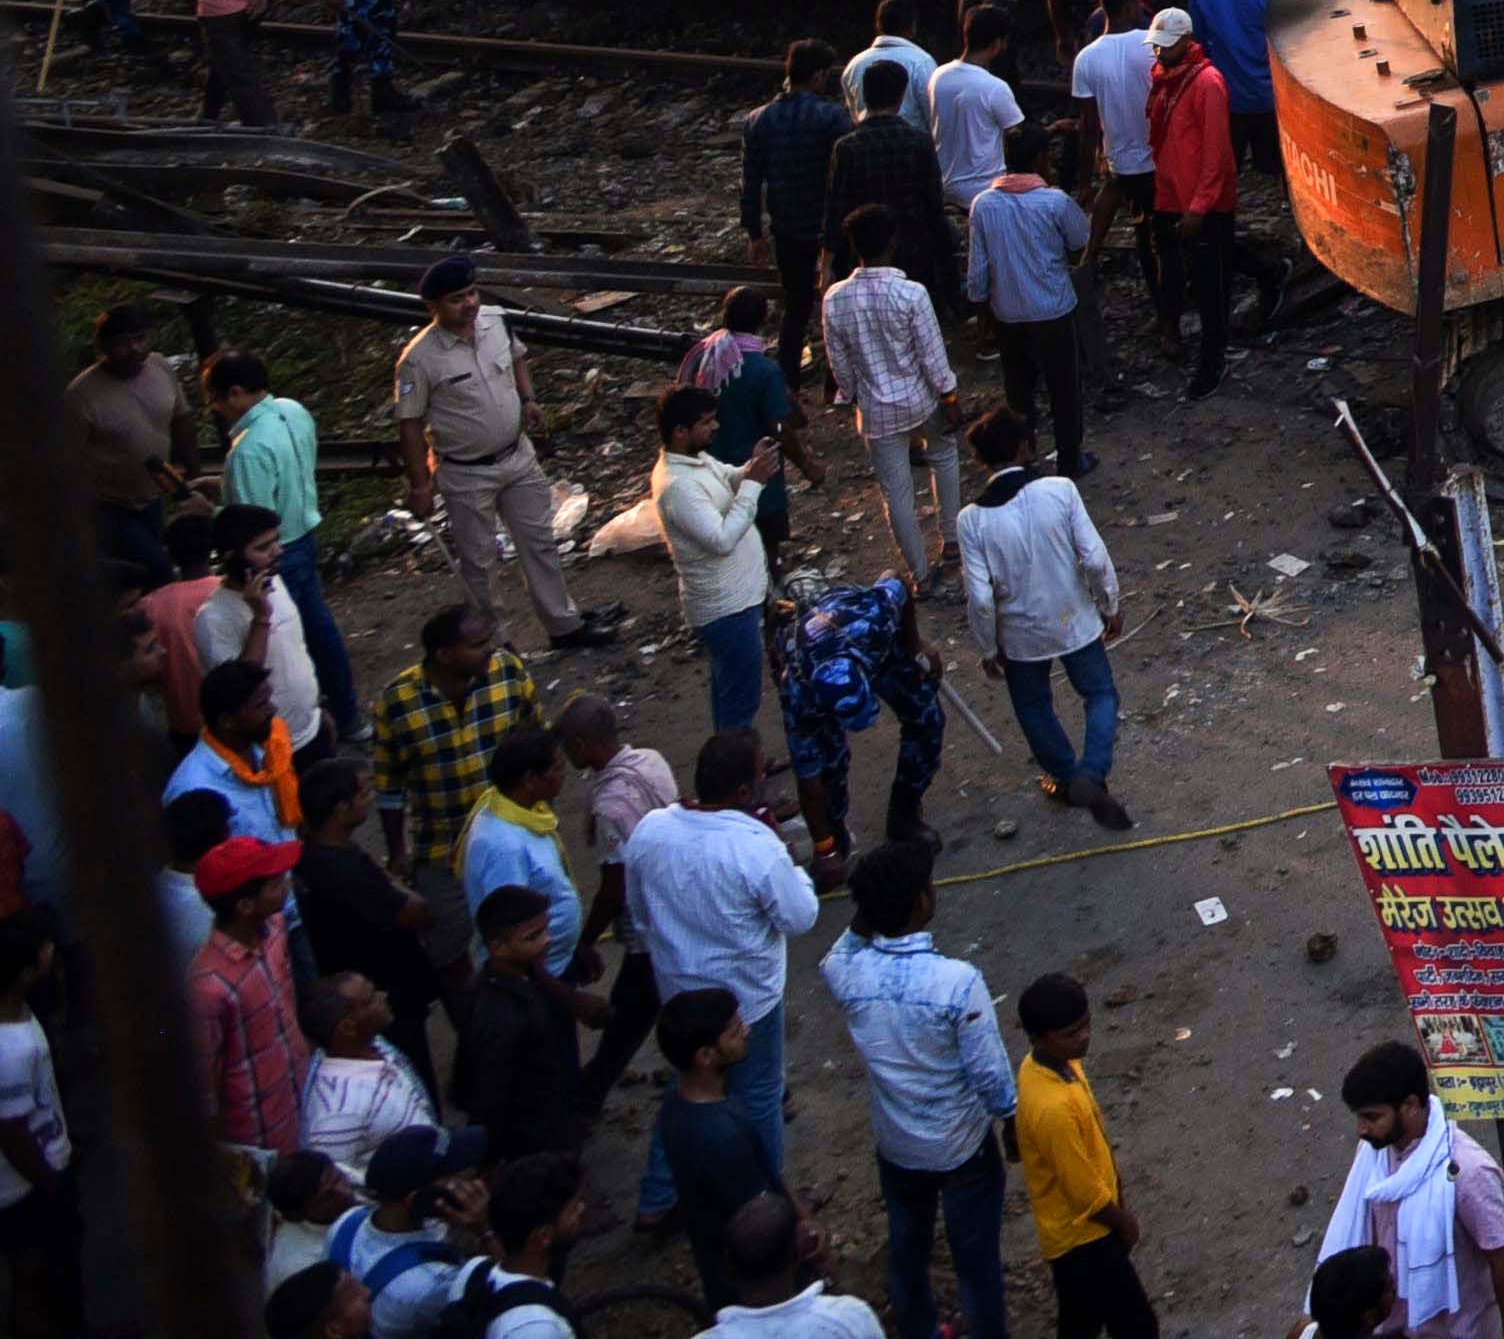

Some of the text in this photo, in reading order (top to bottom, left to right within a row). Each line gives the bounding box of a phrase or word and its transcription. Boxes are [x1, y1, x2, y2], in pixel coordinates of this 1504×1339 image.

[1352, 814, 1446, 872] शांति
[1376, 885, 1437, 930] मैरेज
[1437, 896, 1504, 930] उत्सव
[1437, 1076, 1454, 1089] पता
